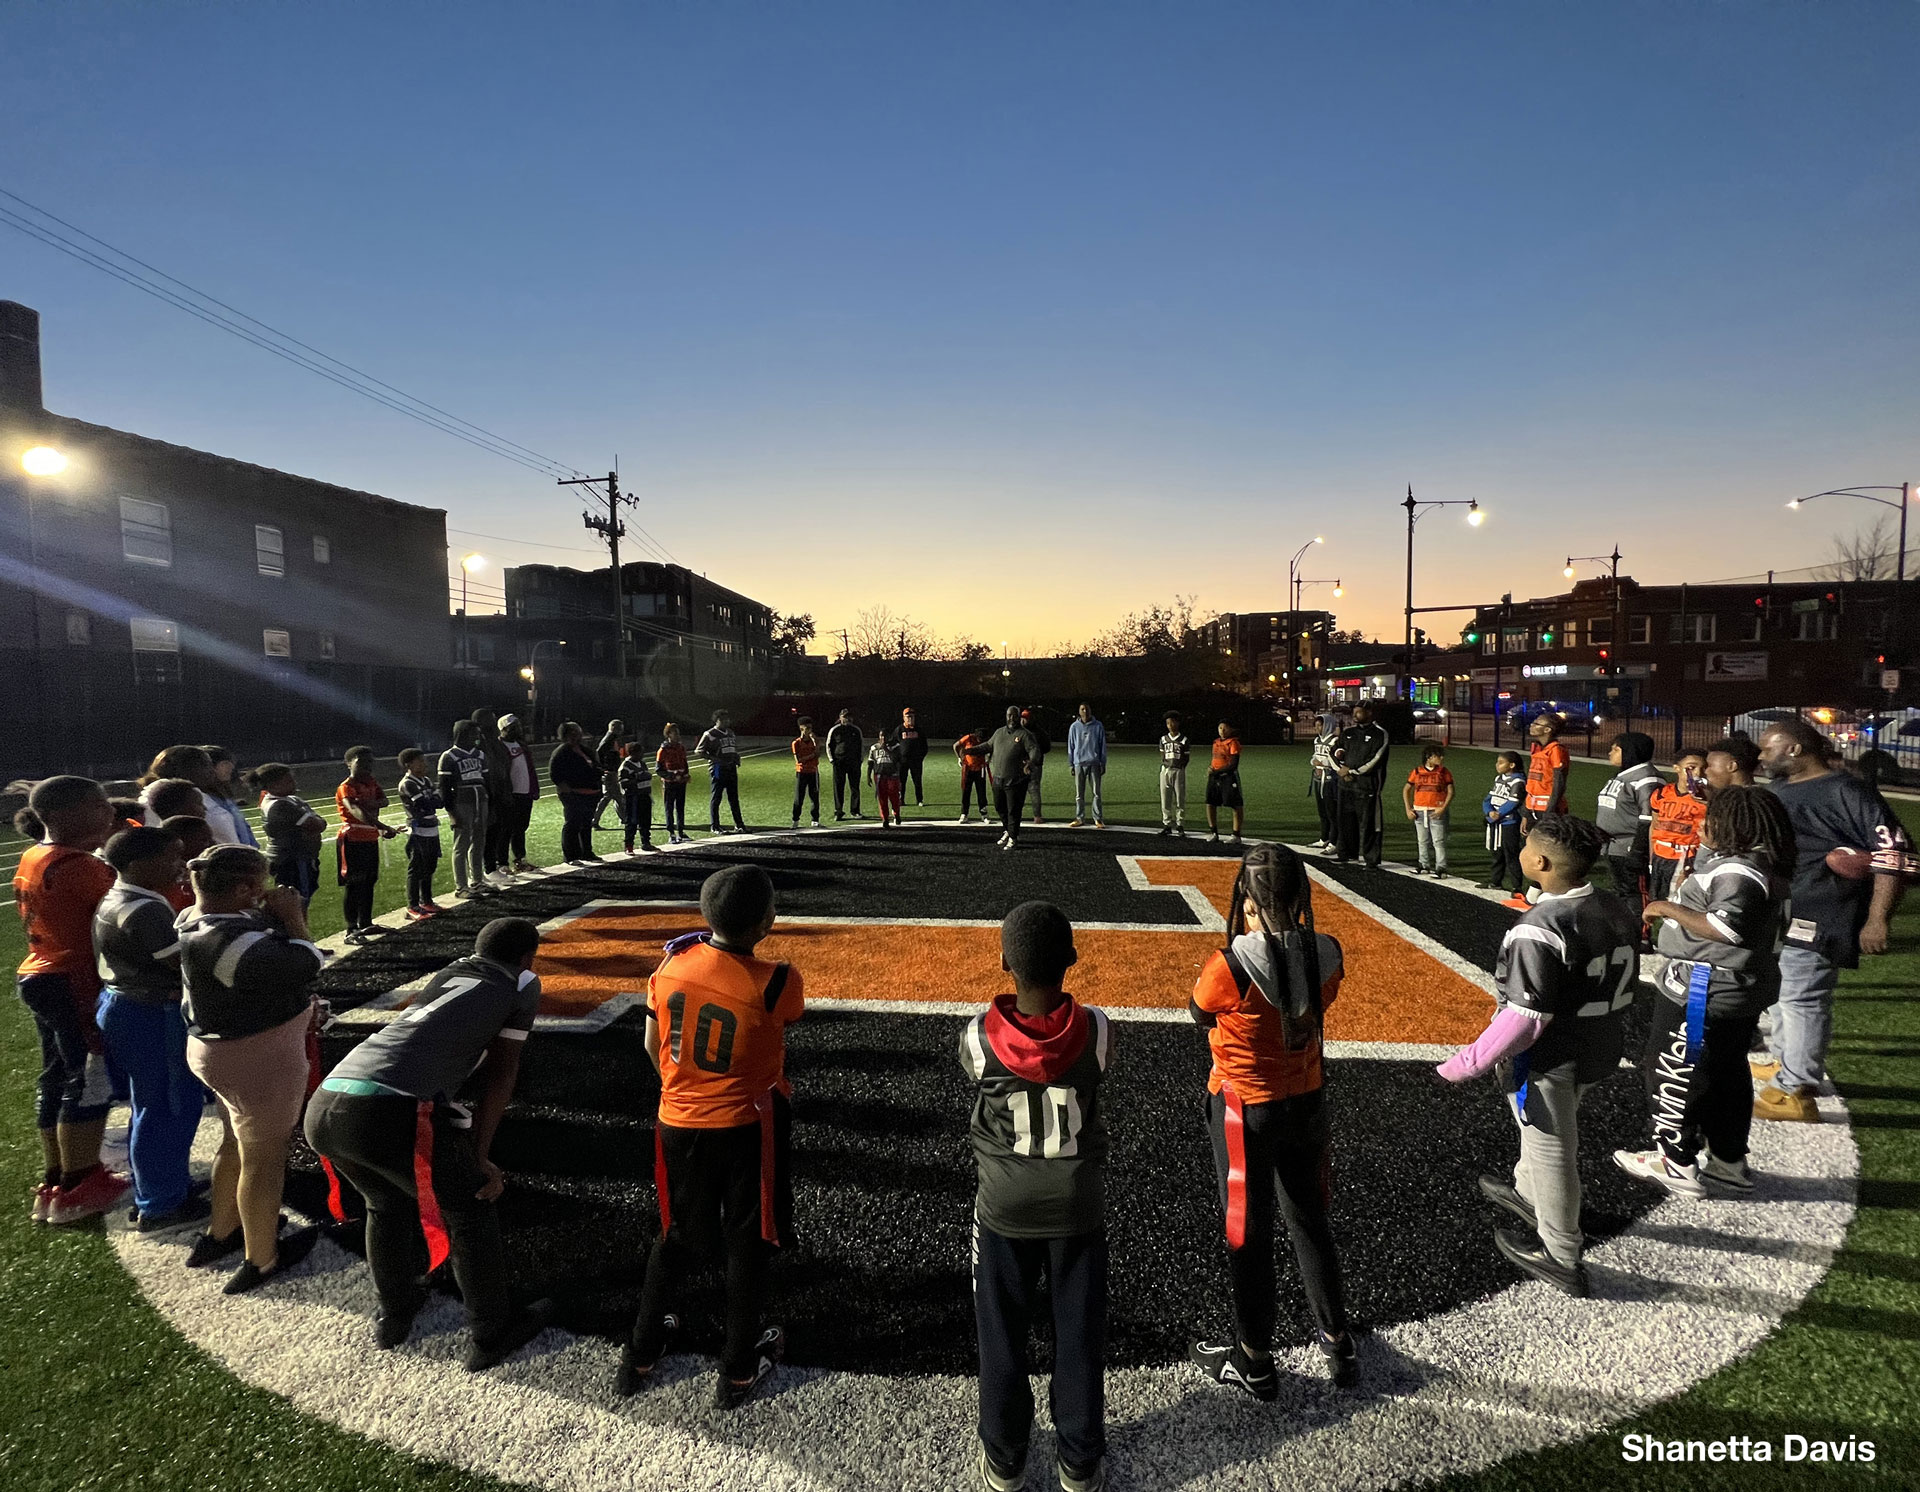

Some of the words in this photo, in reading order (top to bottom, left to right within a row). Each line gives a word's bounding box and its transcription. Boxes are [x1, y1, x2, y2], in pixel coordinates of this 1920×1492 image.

[1875, 825, 1908, 848] 34
[403, 976, 482, 1022] 7
[1576, 945, 1635, 1017] 22
[667, 988, 739, 1075] 10
[1006, 1085, 1082, 1158] 10
